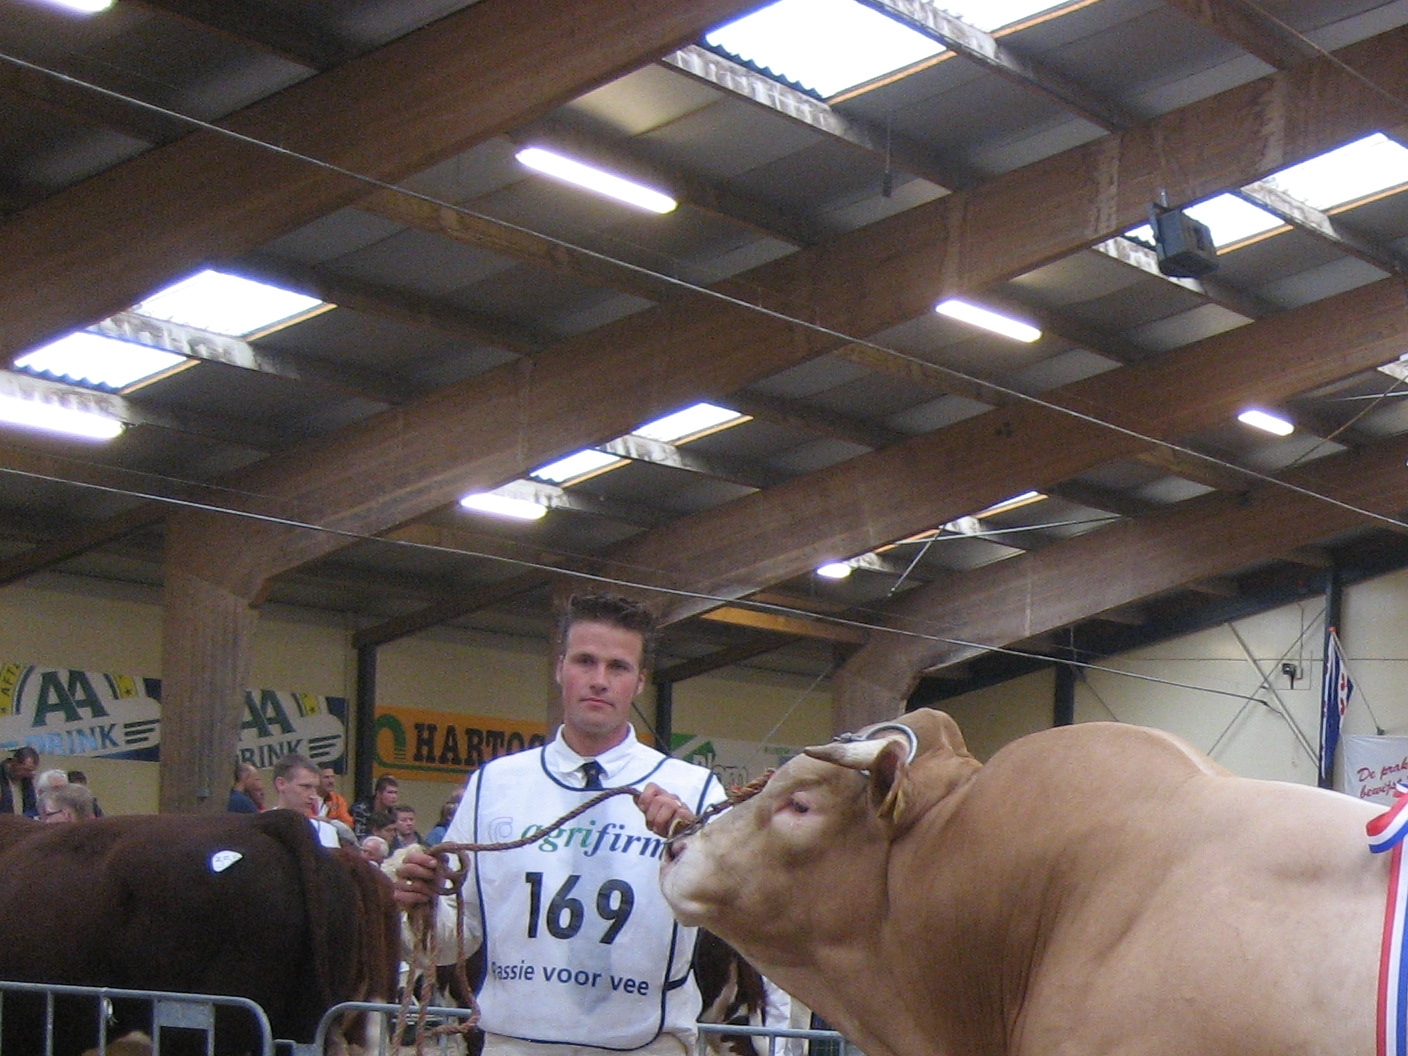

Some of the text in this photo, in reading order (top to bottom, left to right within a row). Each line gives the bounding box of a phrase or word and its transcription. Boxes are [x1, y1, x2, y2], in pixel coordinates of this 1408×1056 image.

[32, 669, 110, 728] AA
[525, 871, 635, 945] 169
[542, 966, 602, 988] voor
[610, 974, 649, 996] vee
